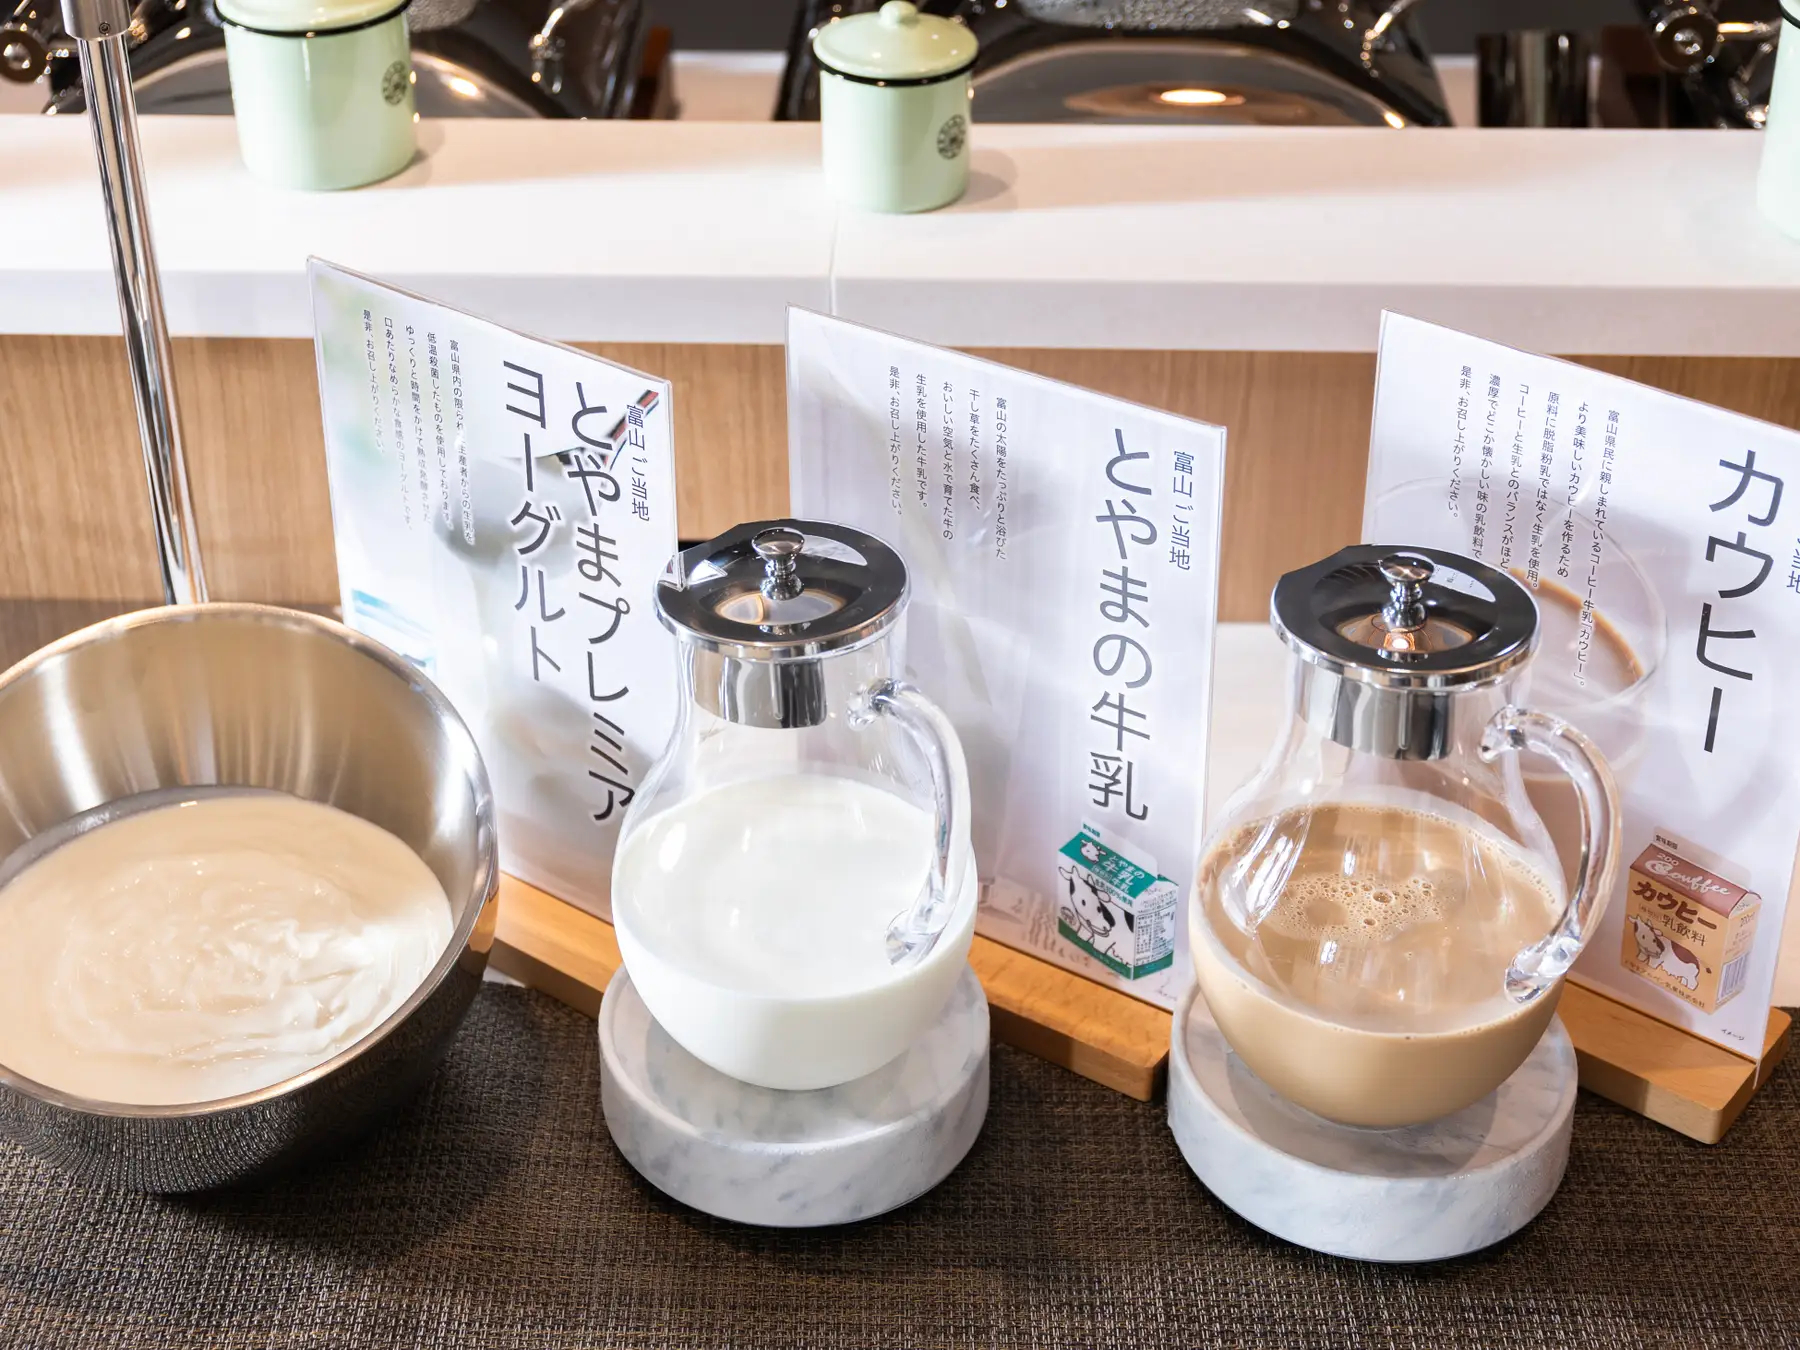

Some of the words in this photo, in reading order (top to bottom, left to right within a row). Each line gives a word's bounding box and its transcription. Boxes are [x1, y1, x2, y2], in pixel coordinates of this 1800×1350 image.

[449, 339, 473, 543] 富山県内の限られ生産者からの生乳を
[503, 360, 567, 682] ヨーグルト
[626, 404, 650, 521] 富山ご当地
[916, 374, 927, 508] 生乳を使用した牛乳です。
[942, 381, 953, 540] おいしい空気と水で育てた牛の
[996, 397, 1007, 560] 富山の太陽をたっぷりと浴びた
[1168, 450, 1195, 571] 富山ご当地
[1448, 365, 1472, 518] 是非、お召し上がりください。
[1500, 383, 1529, 571] コーヒーと生乳とのバランスがほど
[1557, 401, 1589, 578] より美味しいカウヒーを作るため
[1088, 428, 1158, 821] とやまの牛乳
[1696, 449, 1784, 753] カウヒー
[1632, 881, 1717, 930] カウヒー
[1661, 914, 1706, 947] 乳飲料
